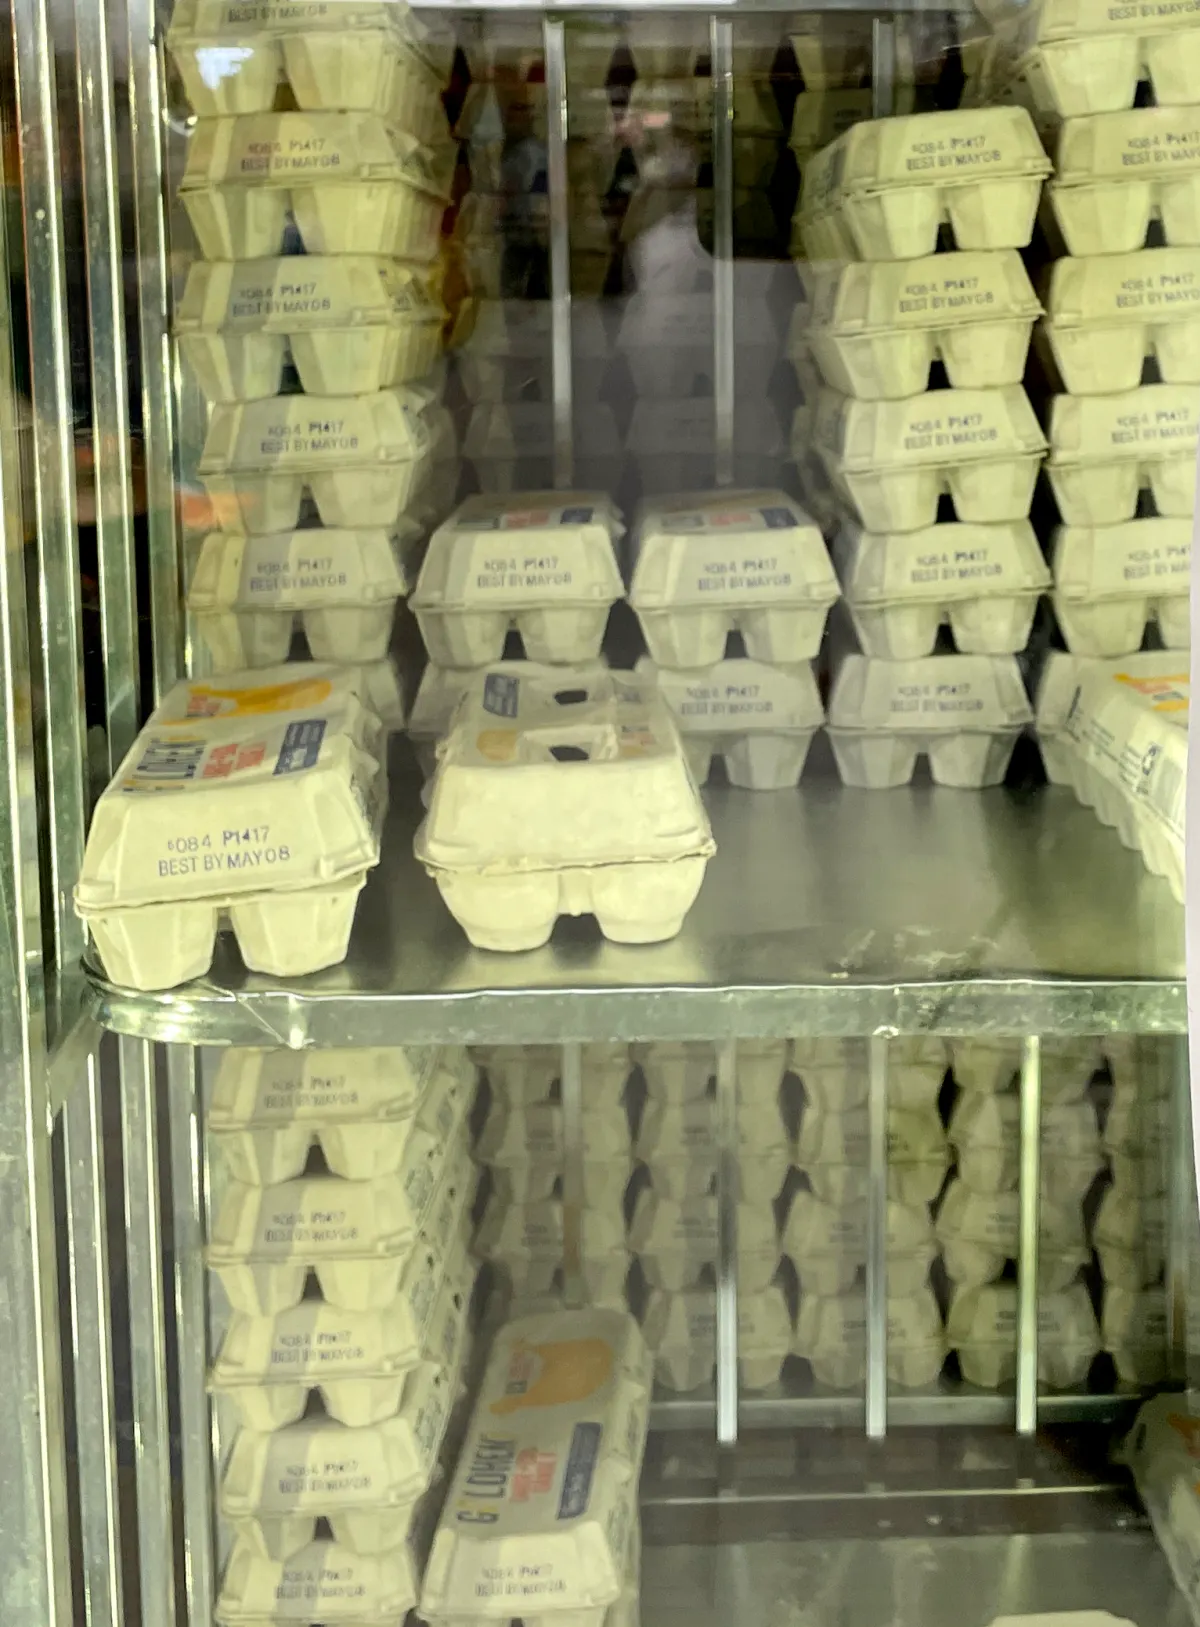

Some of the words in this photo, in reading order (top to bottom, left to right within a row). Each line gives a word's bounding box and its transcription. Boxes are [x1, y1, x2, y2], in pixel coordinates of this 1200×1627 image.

[222, 824, 270, 847] P1417
[158, 856, 199, 876] BEST
[203, 852, 224, 871] BY
